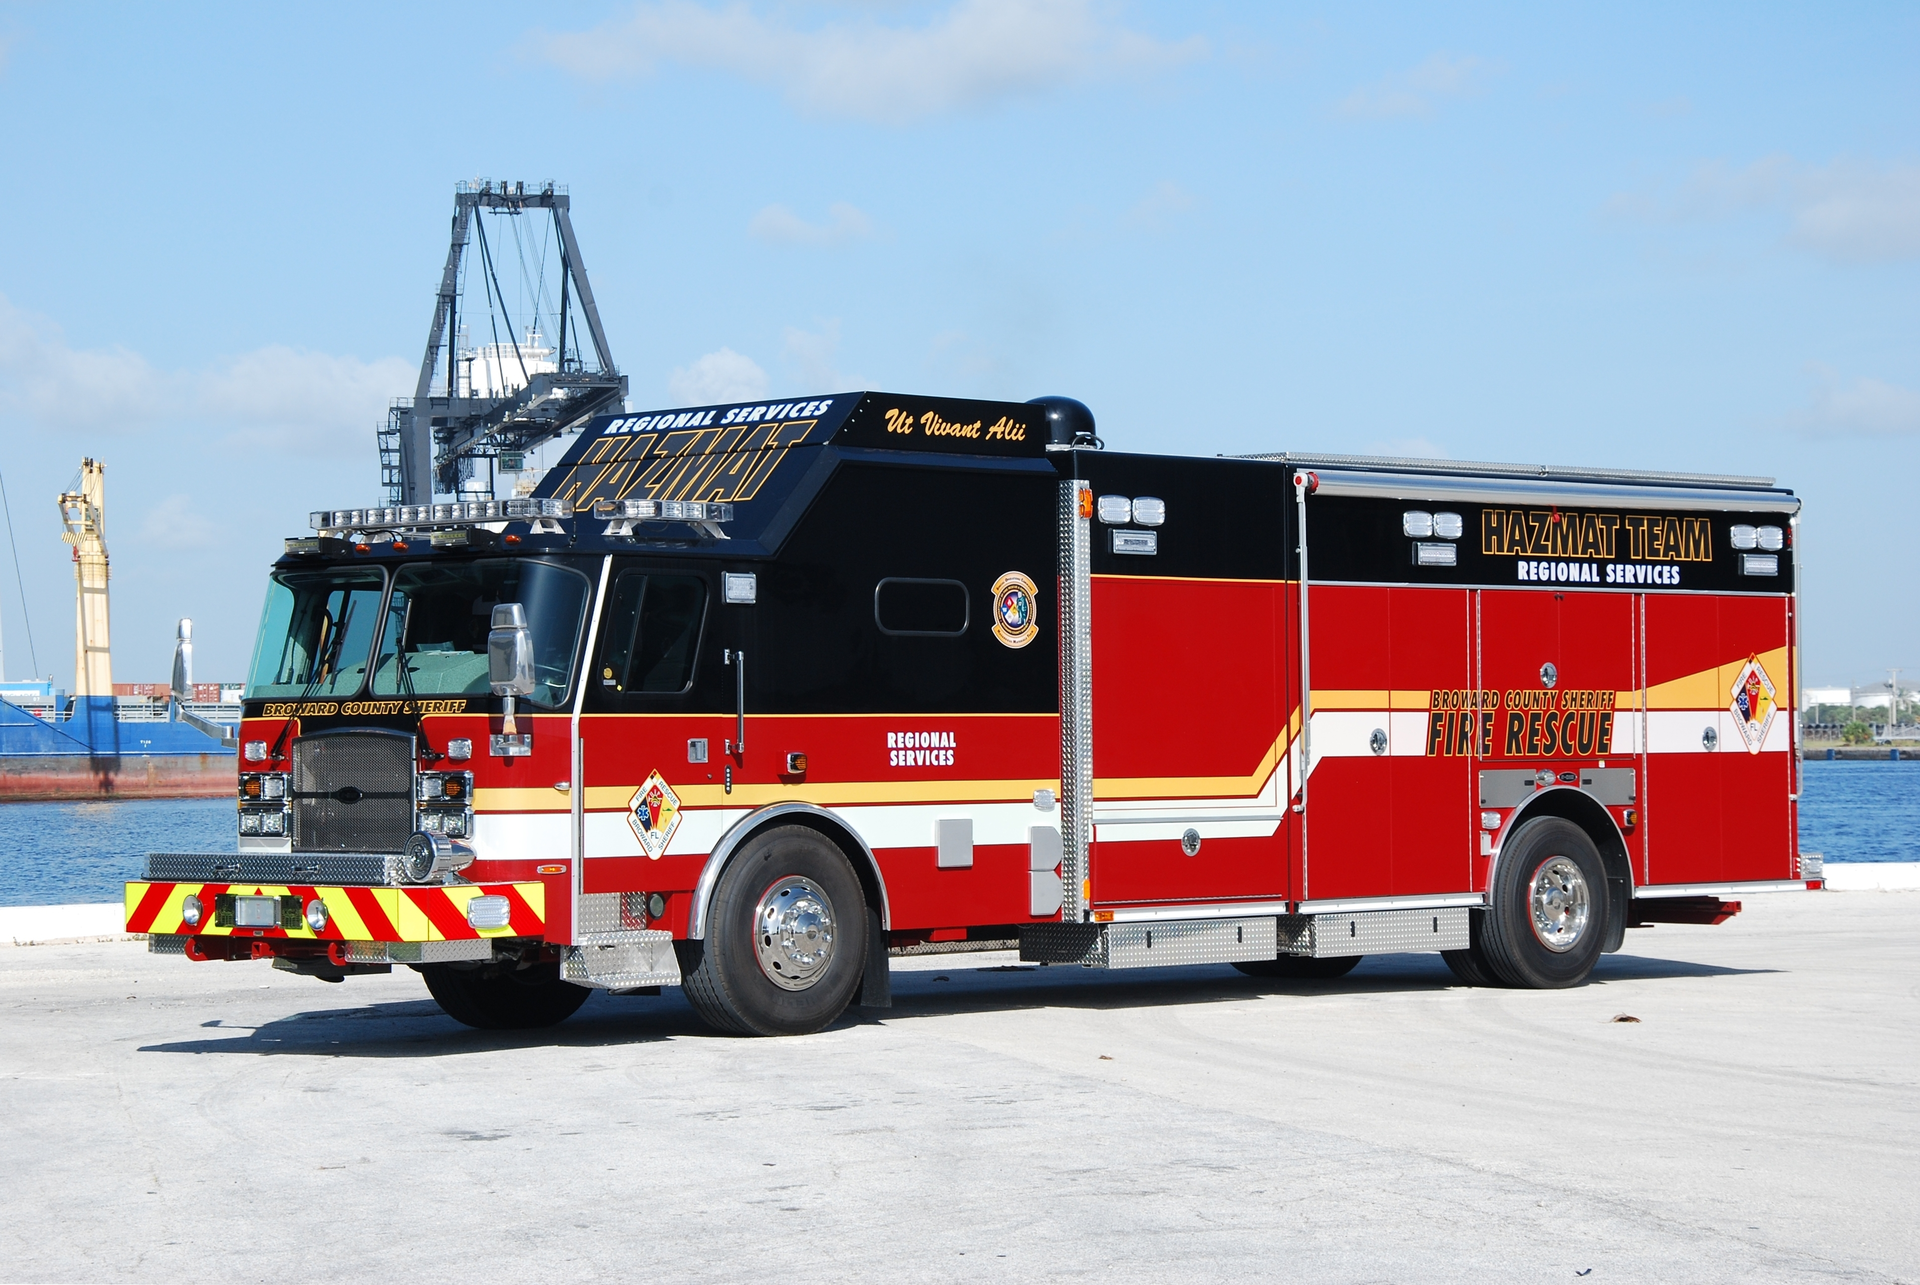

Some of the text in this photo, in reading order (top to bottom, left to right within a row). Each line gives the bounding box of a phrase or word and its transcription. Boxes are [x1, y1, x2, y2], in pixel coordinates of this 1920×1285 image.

[603, 399, 833, 434] REGIONAL SERVICES
[885, 408, 1027, 441] Ut Vivant Alii
[551, 419, 818, 512] HAZMAT
[1482, 508, 1713, 562] HAZMAT TEAM
[1517, 561, 1680, 584] REGIONAL SERVICES
[1736, 672, 1747, 689] FIRE
[1756, 666, 1774, 694] RESCUE
[262, 702, 339, 717] BROWARD
[341, 700, 403, 716] COUNTY
[1431, 689, 1614, 711] BROWARD COUNTY SHERIFF
[887, 731, 957, 749] REGIONAL
[1427, 710, 1613, 757] FIRE RESCUE
[1734, 708, 1753, 746] BROWARD
[1757, 711, 1772, 744] SHERIFF
[889, 749, 955, 767] SERVICES
[635, 786, 648, 802] FIRE
[658, 780, 678, 806] RESCUE
[632, 818, 654, 853] BROWARD
[650, 831, 659, 840] FL
[658, 821, 675, 851] SHERIFF
